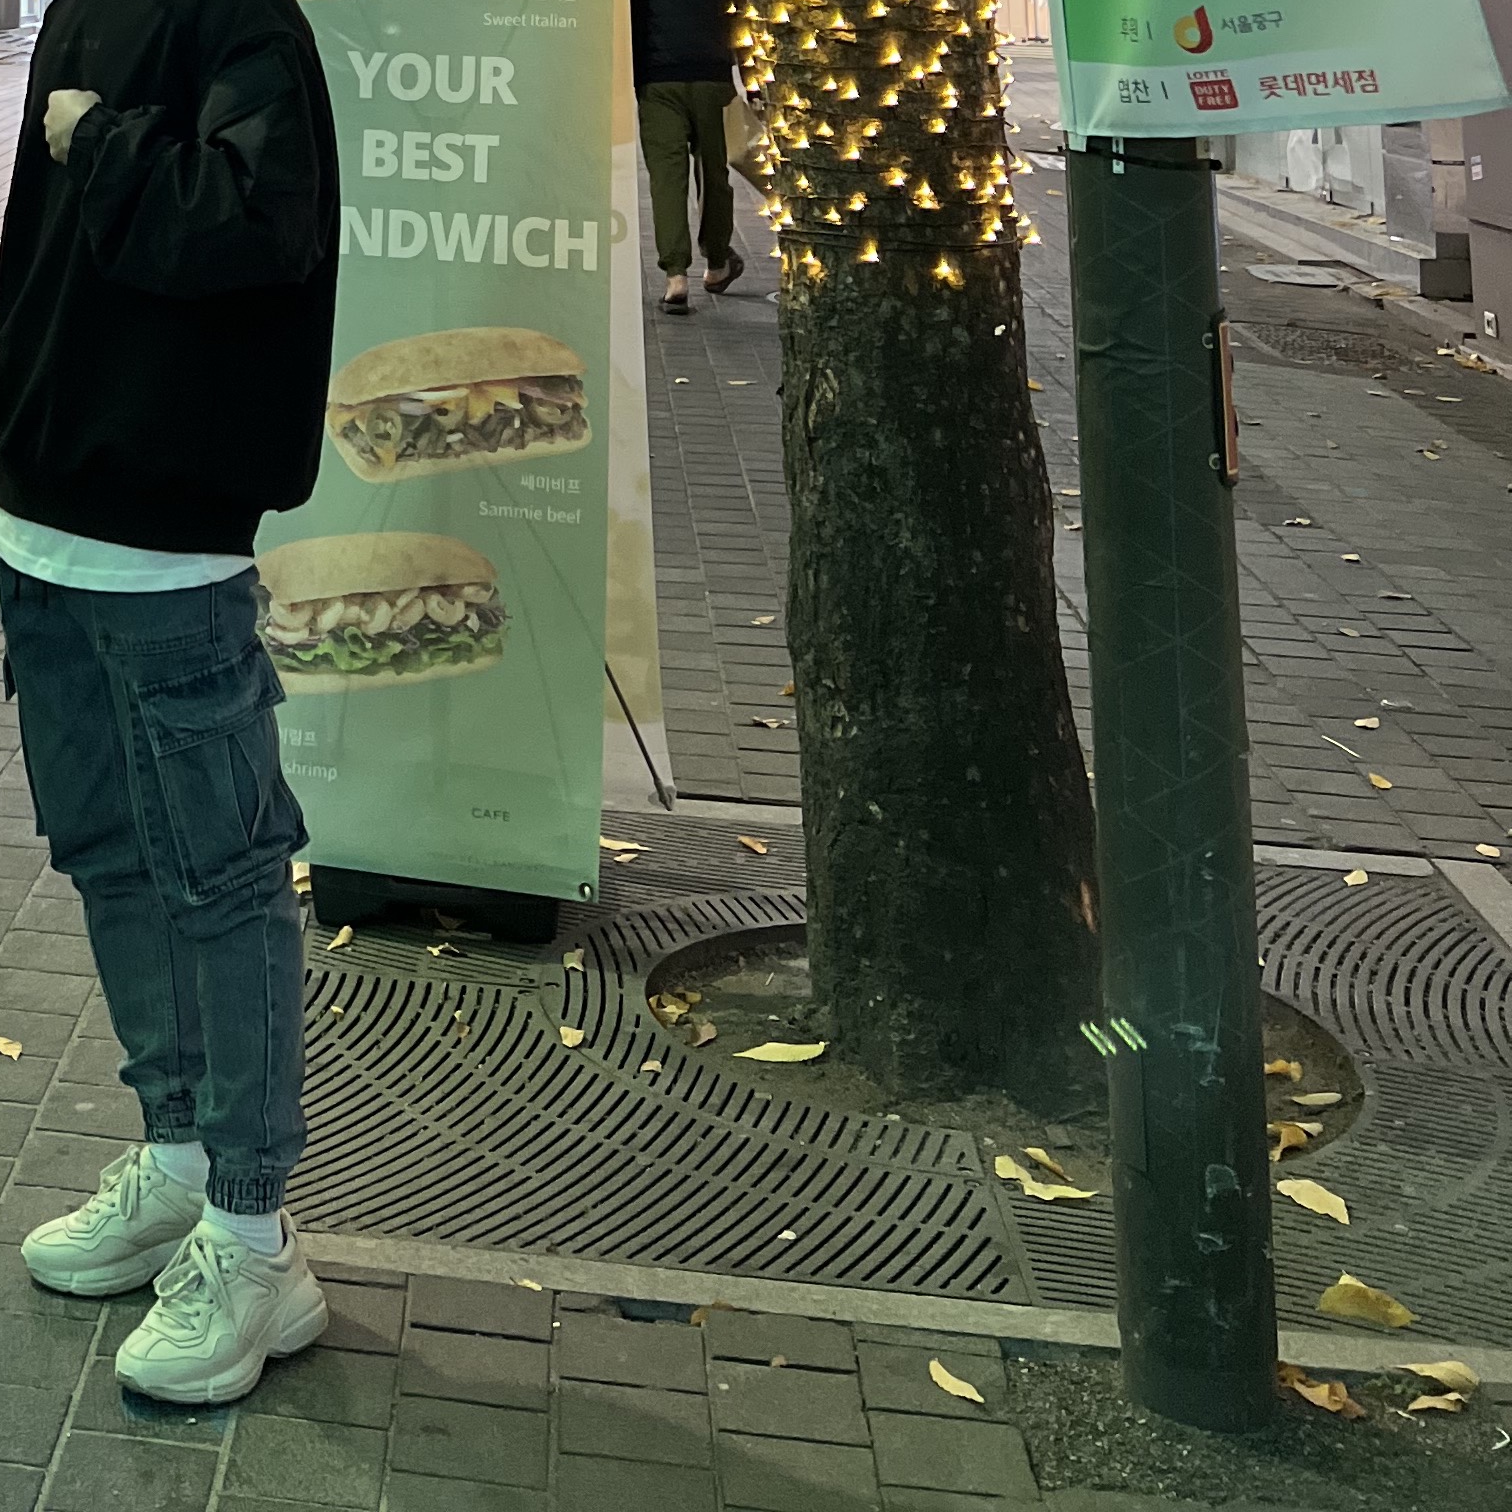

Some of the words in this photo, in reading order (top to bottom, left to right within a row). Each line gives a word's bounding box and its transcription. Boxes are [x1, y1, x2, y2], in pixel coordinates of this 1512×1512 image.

[483, 12, 527, 27] Sweet
[530, 13, 577, 28] Italian
[1220, 10, 1284, 36] 서울중구
[347, 50, 519, 105] YOUR
[1187, 69, 1229, 81] LOTTE
[1259, 69, 1381, 100] 롯데면세점
[1195, 85, 1230, 96] DUTY
[1199, 95, 1234, 107] FREE
[361, 129, 501, 183] BEST
[339, 205, 599, 271] NDWICH
[479, 501, 543, 520] Sammie
[547, 506, 581, 524] beef
[284, 759, 338, 783] shrimp
[471, 807, 511, 822] CAFE
